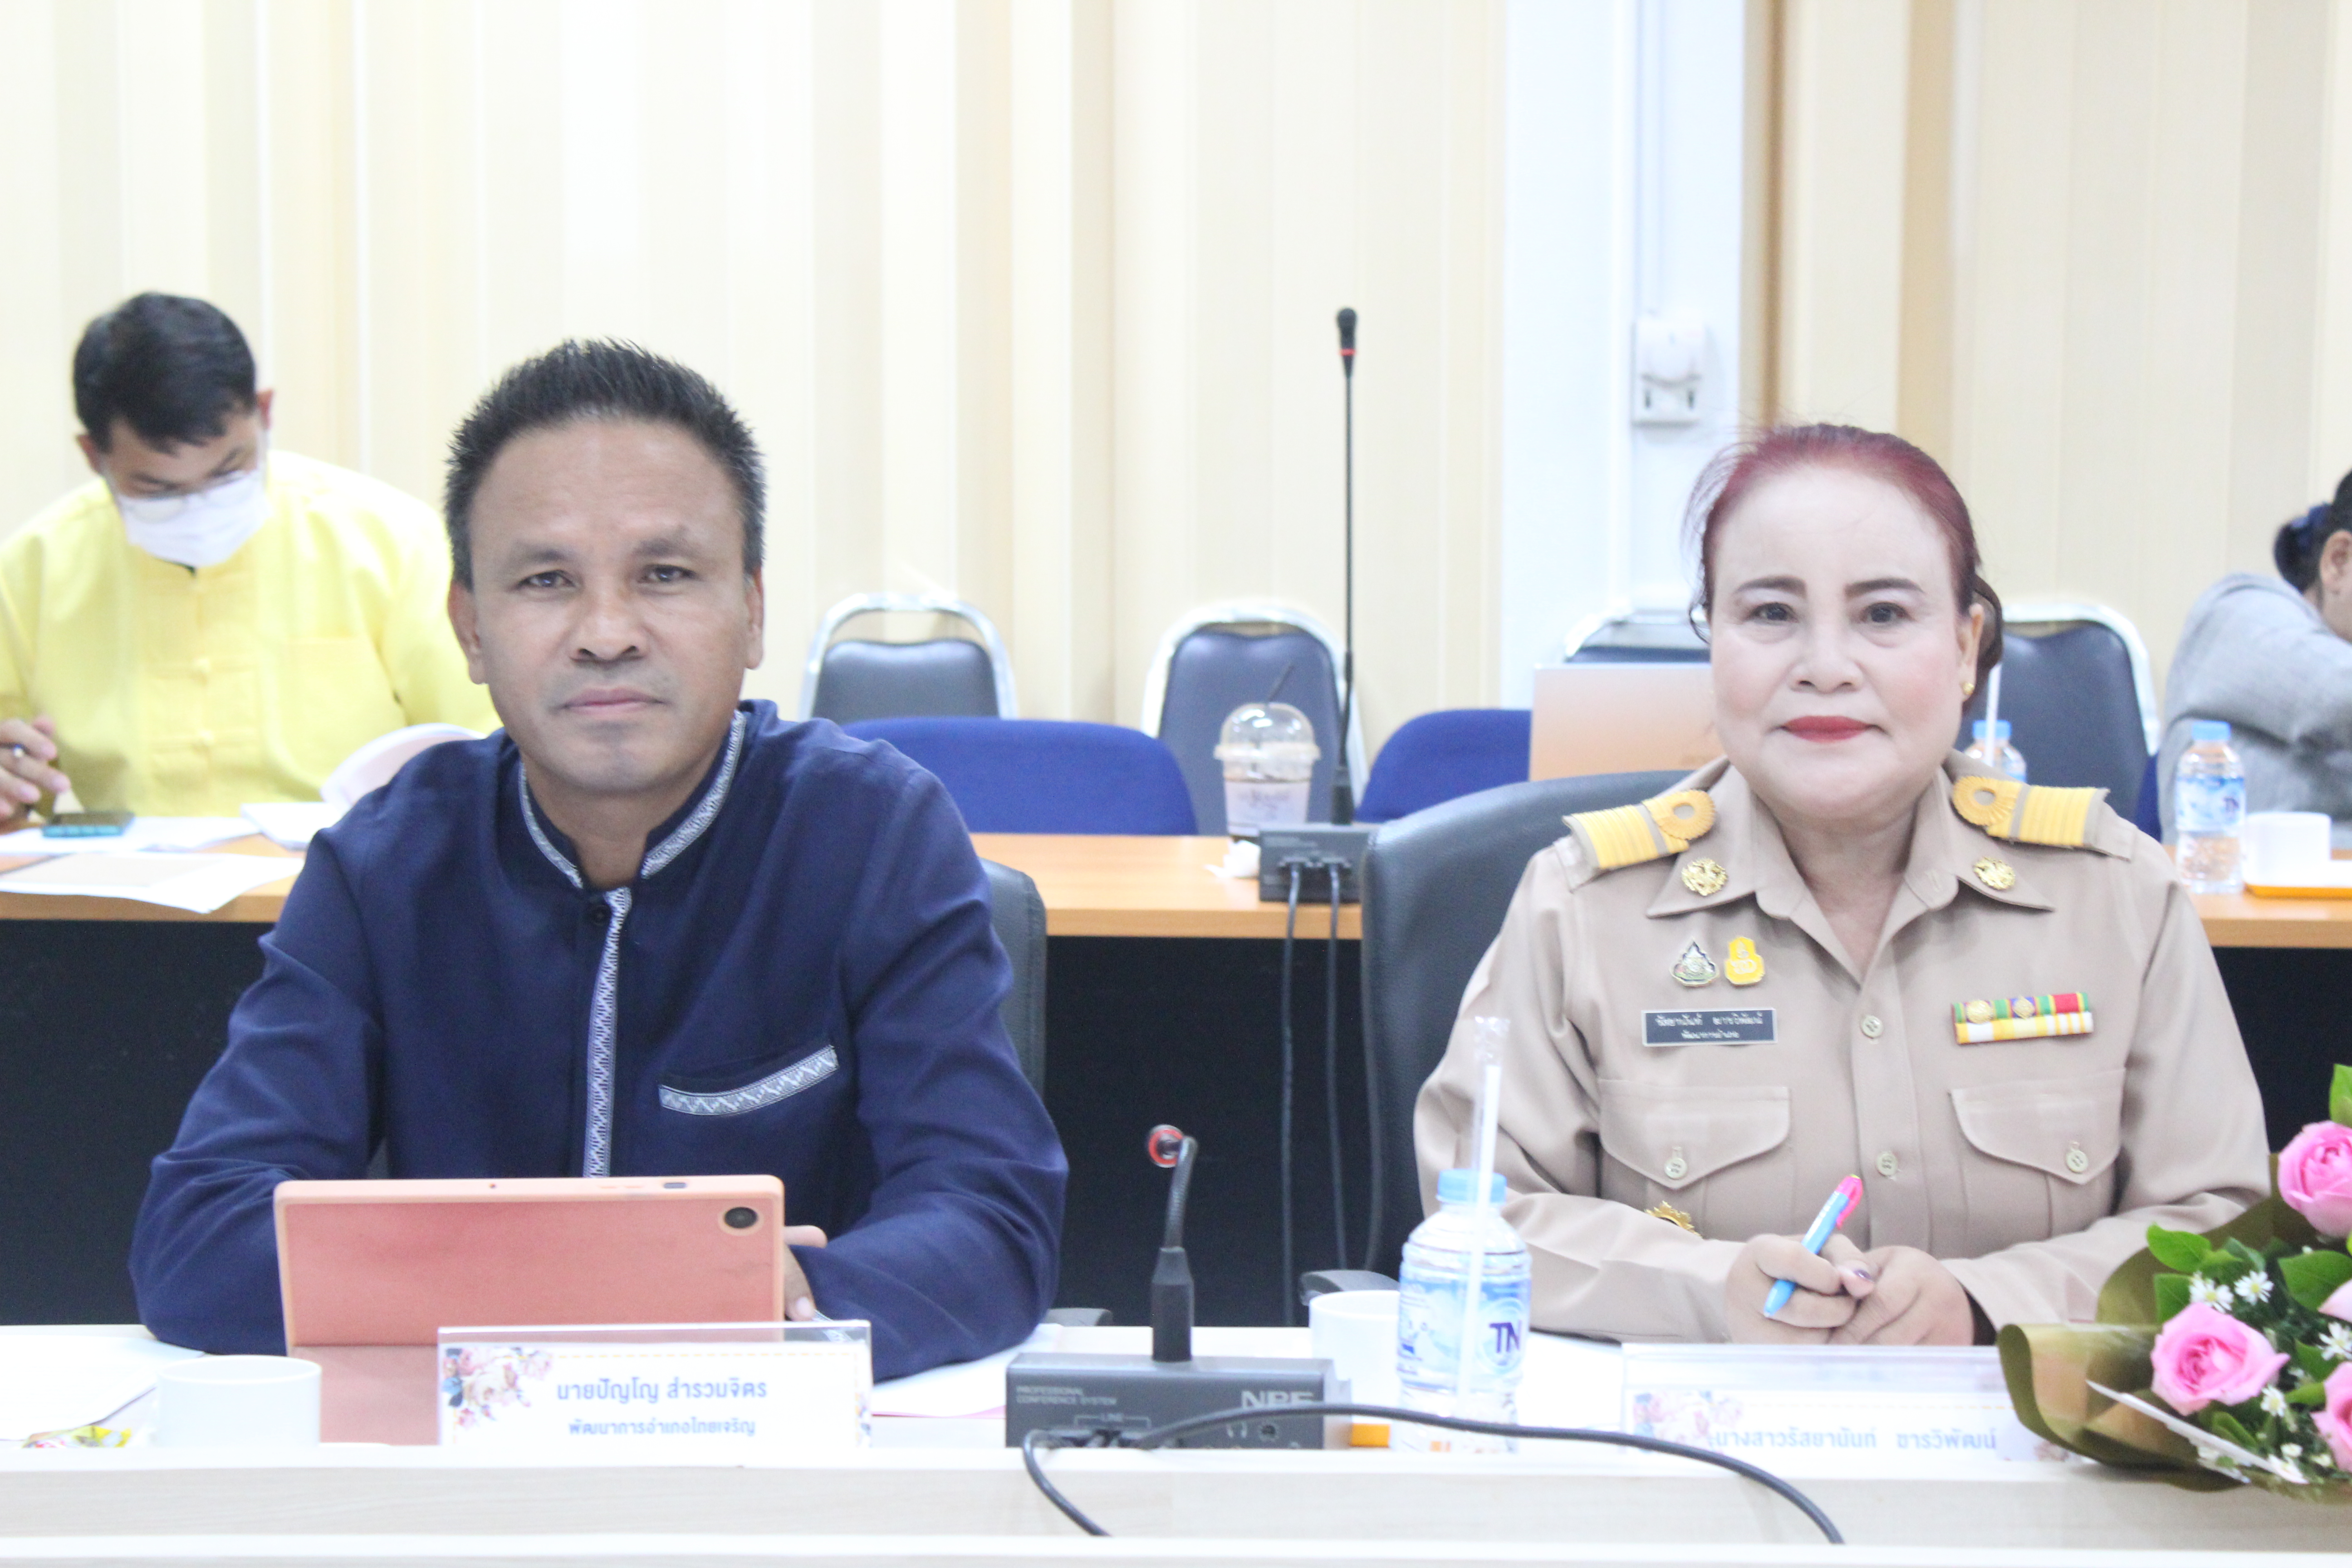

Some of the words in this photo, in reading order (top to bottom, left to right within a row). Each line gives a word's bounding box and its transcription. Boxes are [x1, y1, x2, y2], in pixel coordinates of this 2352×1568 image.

[557, 1377, 659, 1404] นายปัญโญ
[667, 1376, 767, 1399] สำรวมจิตร
